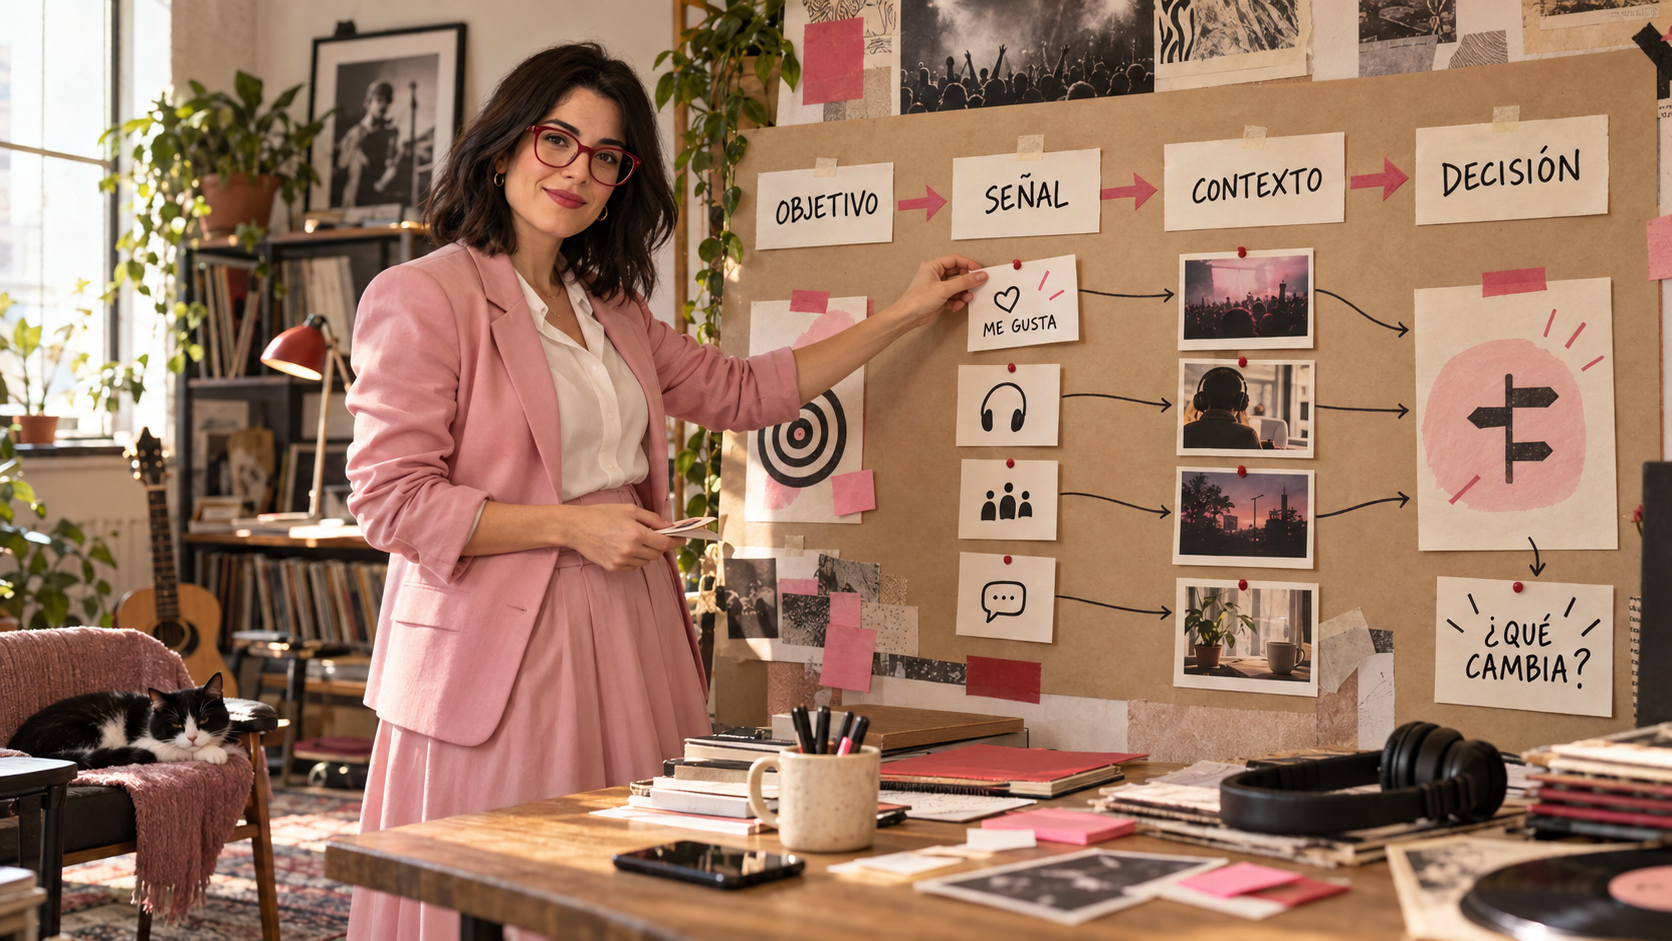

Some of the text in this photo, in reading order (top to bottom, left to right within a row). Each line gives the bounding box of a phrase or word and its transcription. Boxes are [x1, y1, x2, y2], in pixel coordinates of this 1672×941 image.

[1192, 167, 1323, 204] CONTEXTO
[1441, 145, 1580, 198] DECISIÓN
[775, 189, 879, 225] OBJETIVO
[985, 172, 1069, 215] SEÑAL
[983, 314, 1057, 338] ME GUSTA
[1484, 613, 1552, 649] ¿QUÉ
[1465, 647, 1591, 690] CAMBIA?
